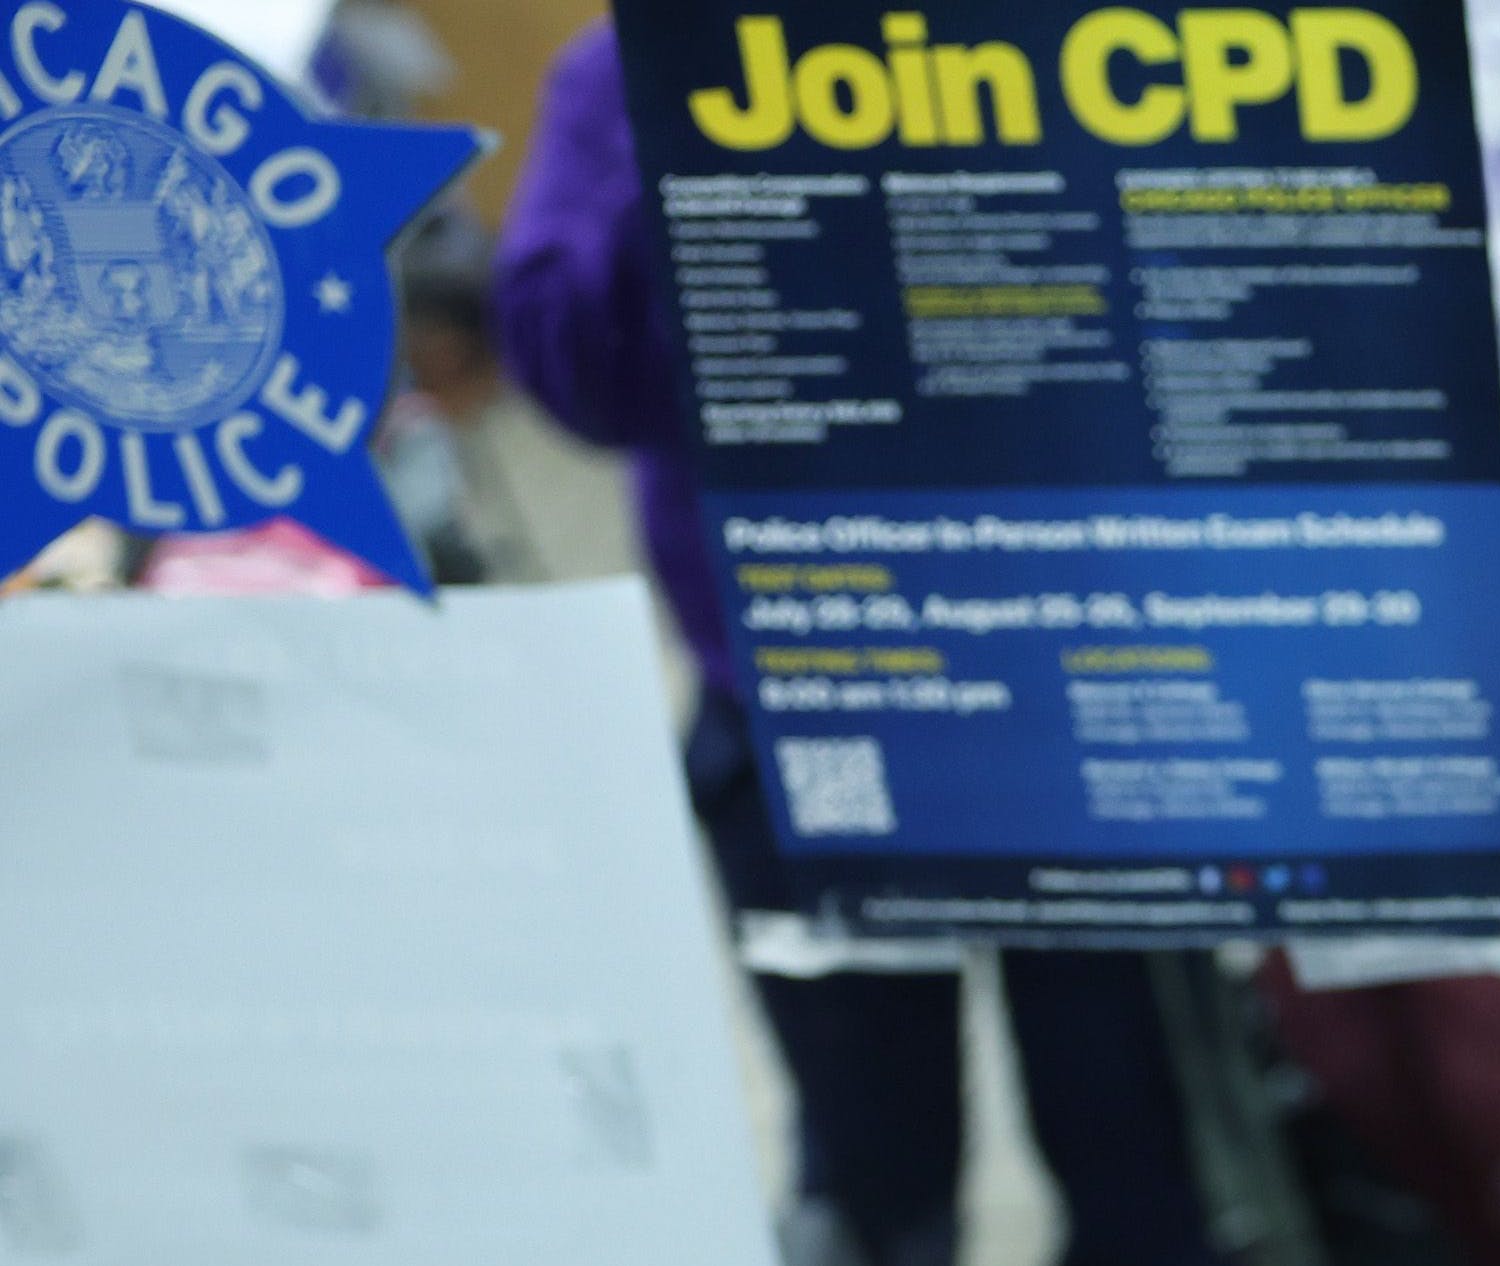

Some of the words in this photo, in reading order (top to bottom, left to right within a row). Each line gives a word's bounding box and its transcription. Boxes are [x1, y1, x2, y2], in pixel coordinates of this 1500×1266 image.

[687, 12, 1043, 151] Join
[1059, 7, 1419, 147] CPD
[724, 516, 825, 552] Police
[826, 515, 934, 552] Officer
[1088, 514, 1207, 550] Written
[1207, 512, 1294, 549] Exam
[1296, 511, 1446, 548] Schedule
[743, 596, 811, 636] July
[922, 593, 1036, 635] August
[1144, 590, 1318, 630] September
